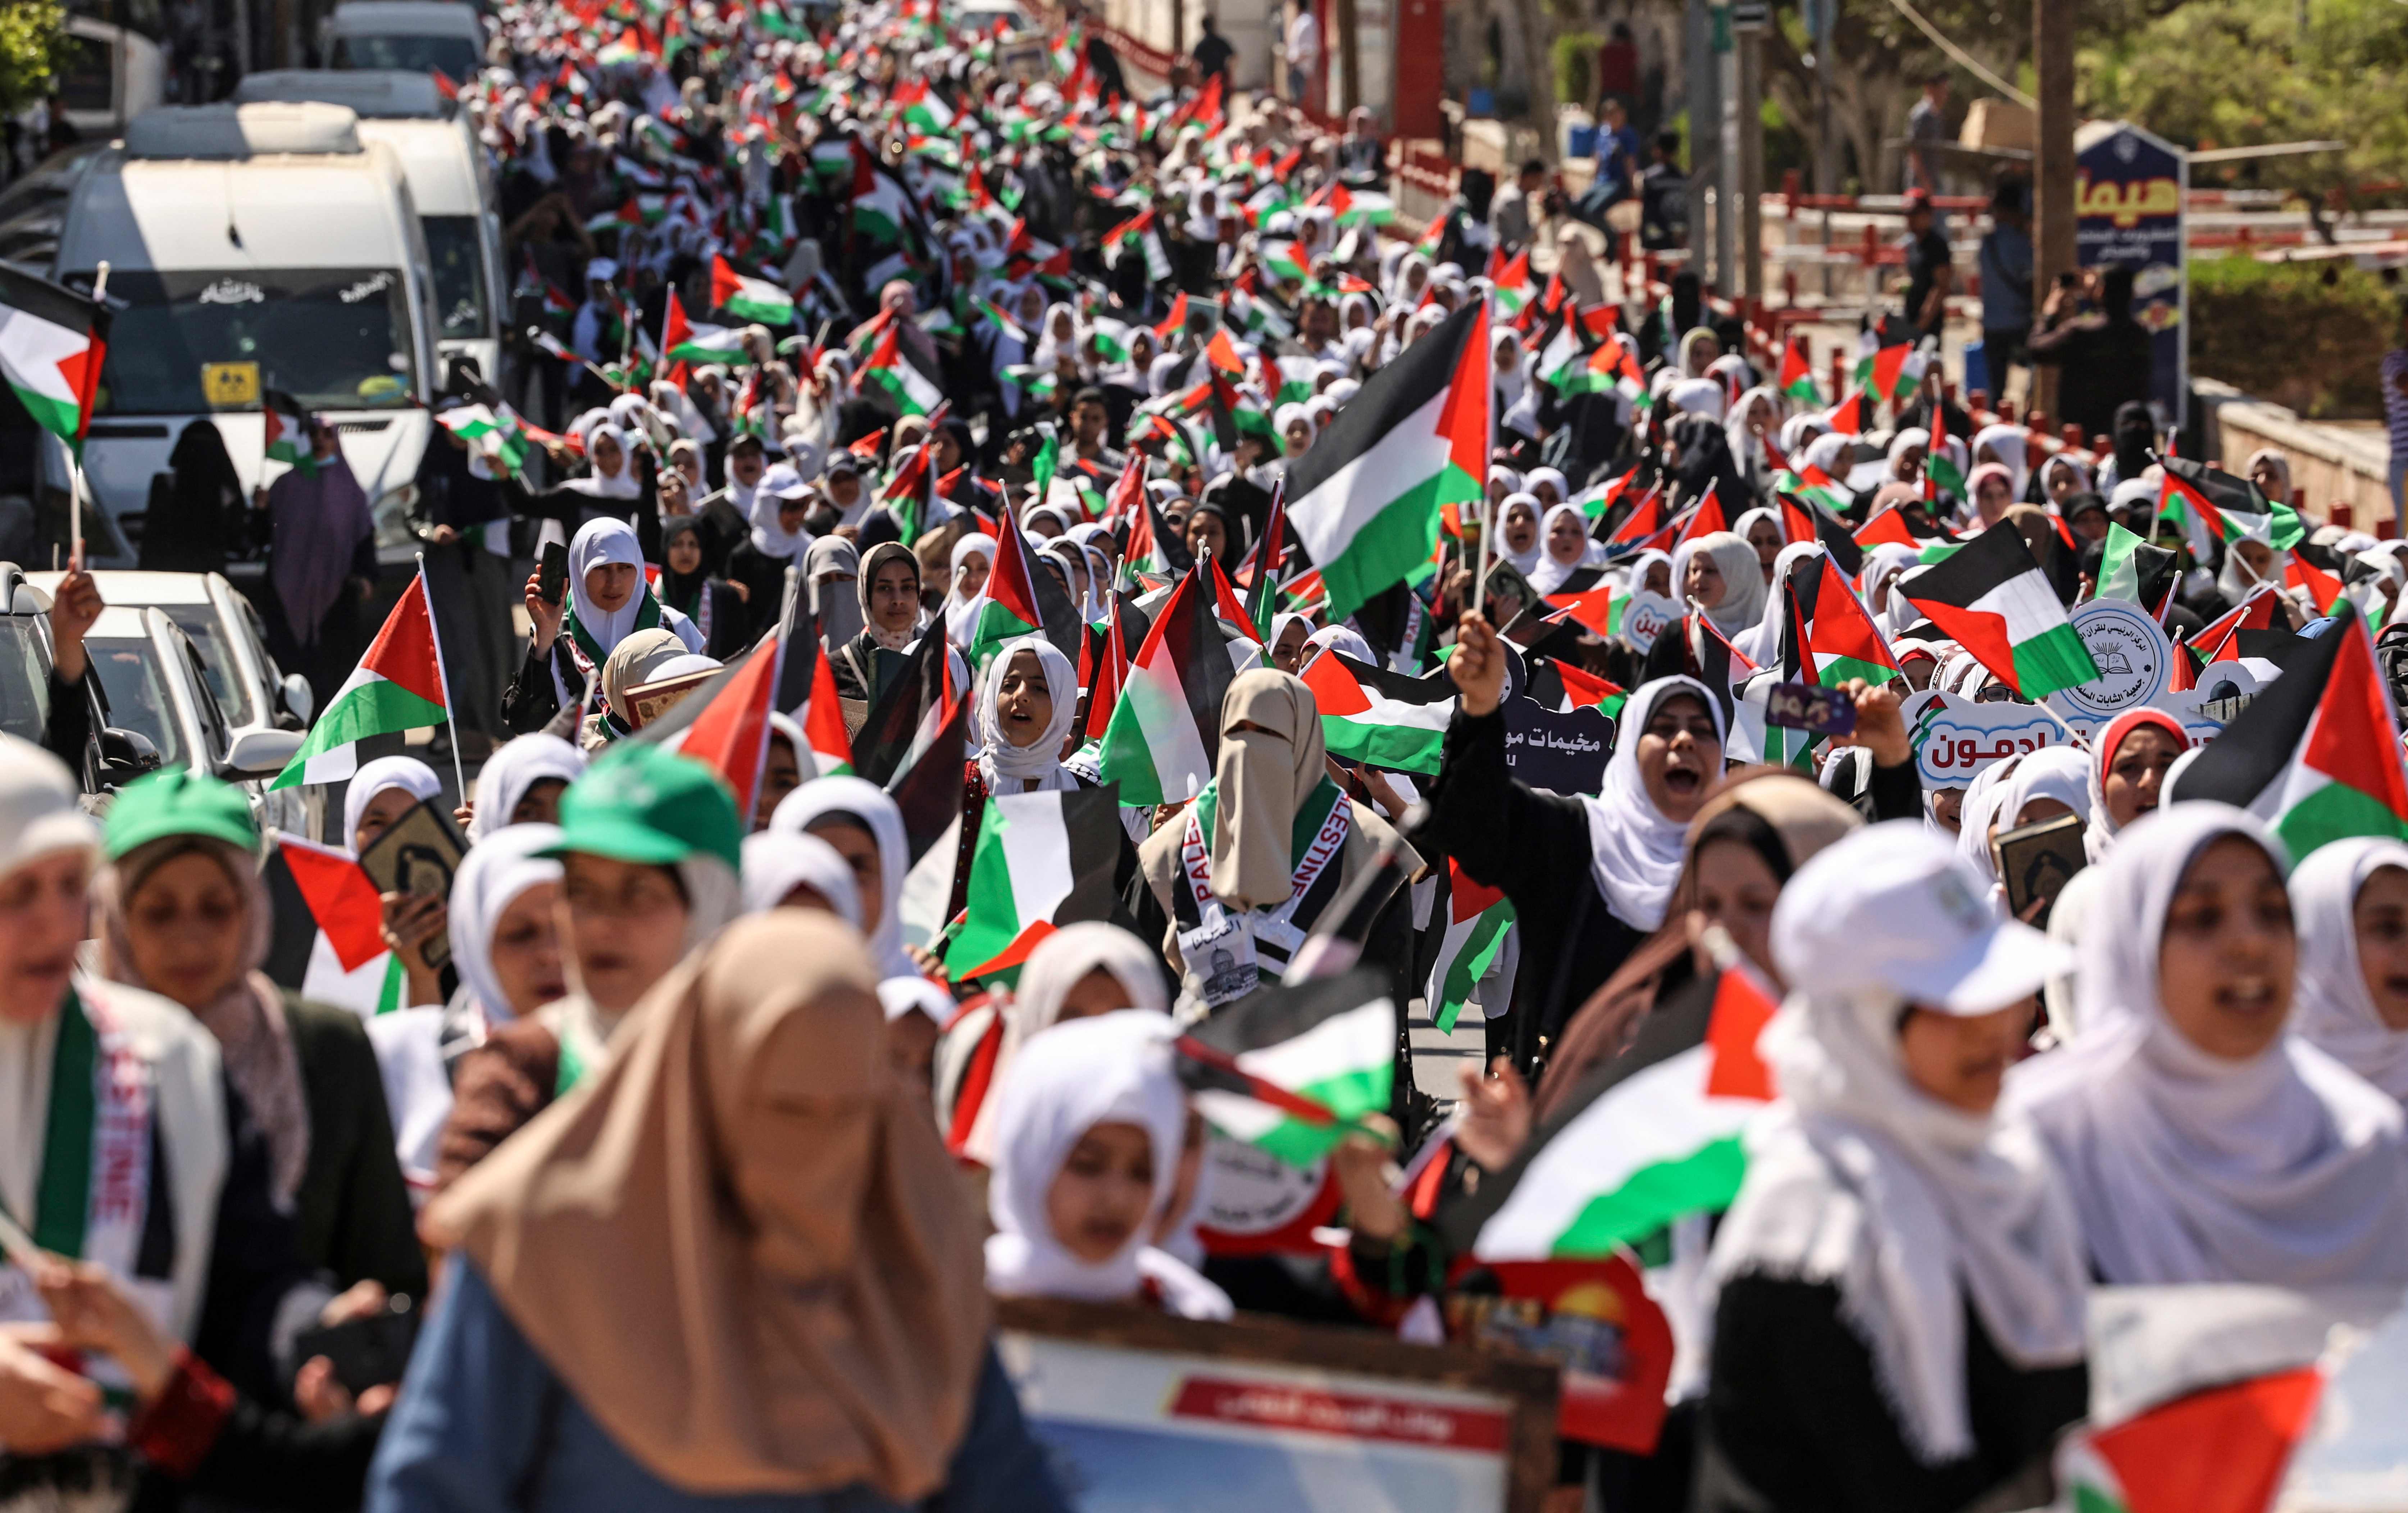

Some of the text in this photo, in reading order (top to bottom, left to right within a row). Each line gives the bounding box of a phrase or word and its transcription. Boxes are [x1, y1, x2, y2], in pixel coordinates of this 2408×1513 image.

[2086, 623, 2106, 638] للقرآن
[2107, 626, 2134, 637] الرئيسي
[2131, 635, 2147, 652] المركز
[2122, 678, 2145, 698] جمعية
[2097, 693, 2123, 707] الشابات
[1528, 728, 1600, 756] مخيمات
